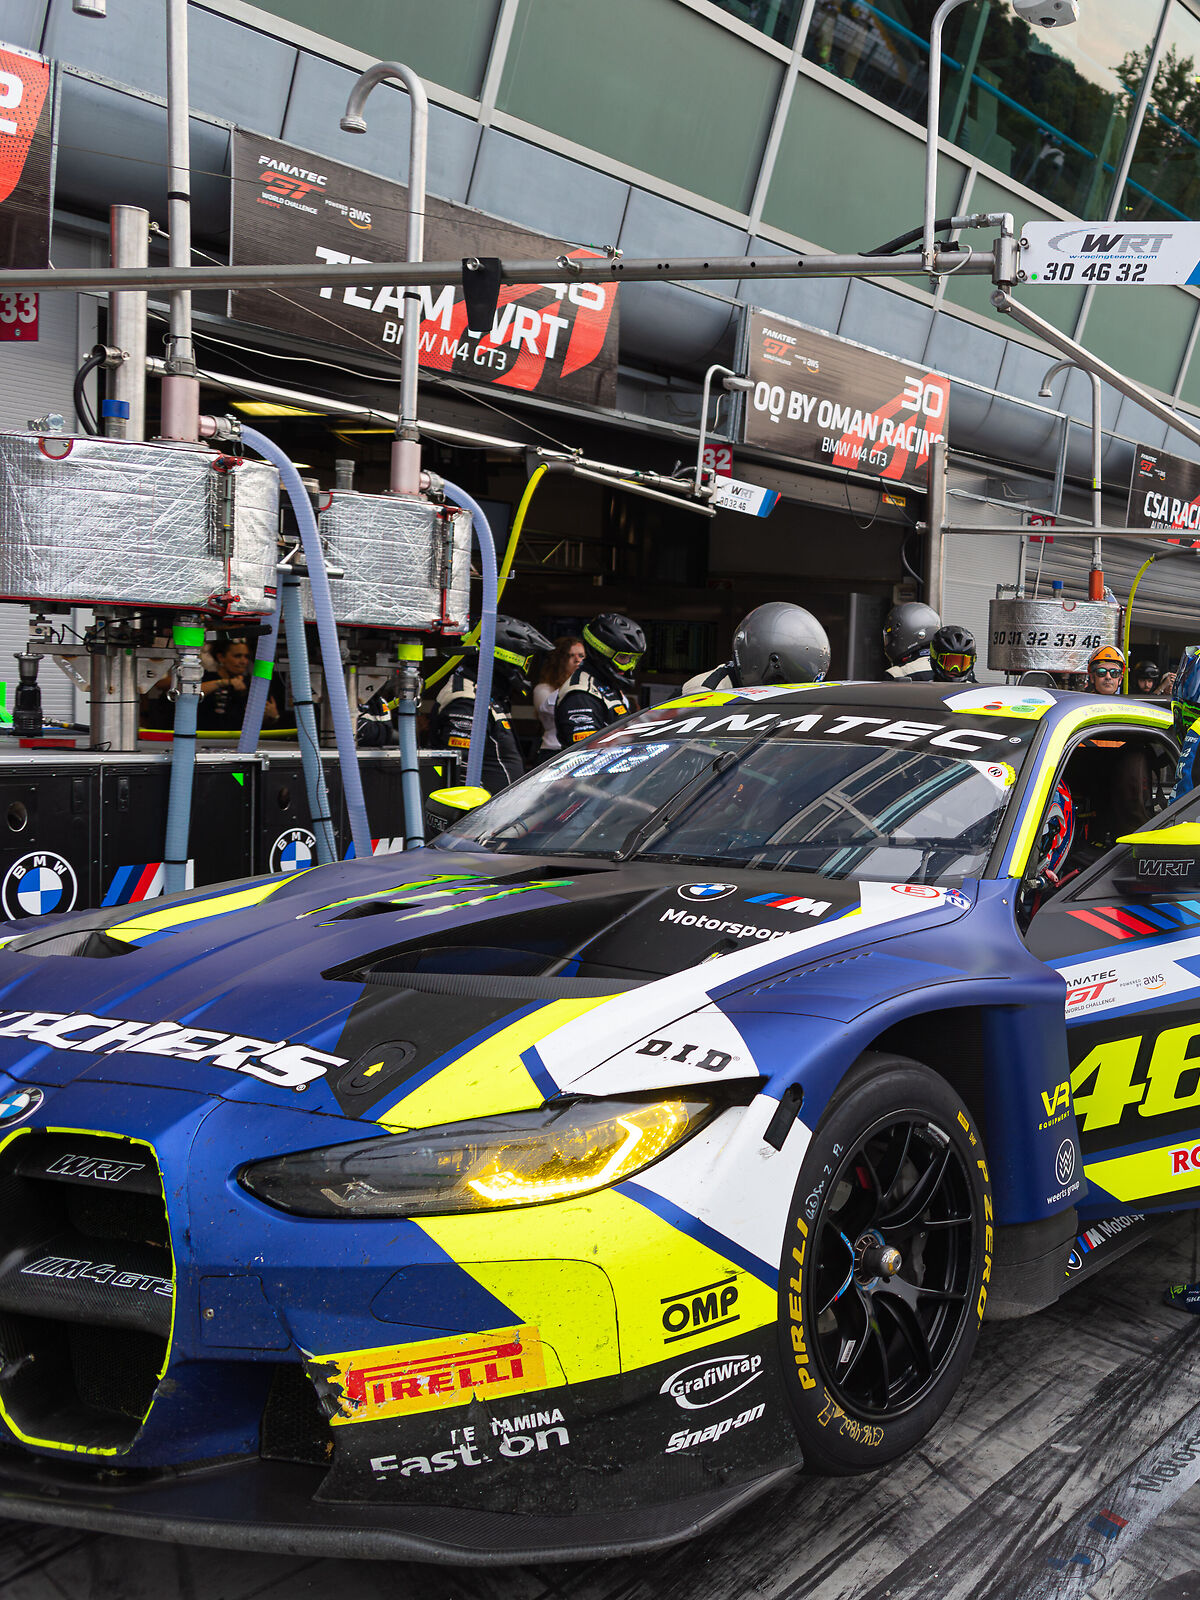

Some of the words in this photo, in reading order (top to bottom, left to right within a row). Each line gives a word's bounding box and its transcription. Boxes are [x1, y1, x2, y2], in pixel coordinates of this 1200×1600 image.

[258, 155, 328, 186] FANATEC
[259, 170, 328, 200] GT
[261, 191, 284, 205] WORLD
[284, 199, 319, 215] CHALLENGE
[348, 207, 372, 223] aws
[1080, 233, 1173, 253] WRT
[1043, 262, 1075, 282] 30
[1081, 263, 1115, 282] 46
[1115, 263, 1149, 282] 32
[382, 321, 438, 353] BW
[440, 339, 469, 362] M4
[473, 346, 507, 371] GT3
[762, 327, 797, 345] FANATEC
[901, 375, 944, 419] 30
[787, 390, 818, 423] BY
[817, 400, 879, 441] OMAN
[703, 449, 731, 470] 32
[822, 437, 851, 459] BMW
[851, 445, 867, 461] M4
[868, 447, 888, 467] GT3
[731, 485, 755, 499] WRT
[1143, 491, 1169, 521] CSA
[993, 631, 1006, 645] 30
[1007, 631, 1022, 645] 31
[1026, 632, 1049, 646] 32
[1053, 633, 1077, 648] 33
[1081, 635, 1101, 649] 46
[597, 712, 1009, 753] FANATEC
[13, 856, 69, 881] BMW
[1138, 859, 1196, 876] WRT
[1066, 968, 1117, 988] ANATEC
[1120, 978, 1142, 988] POWERED
[1143, 973, 1165, 986] aws
[1065, 1002, 1085, 1014] WORLD
[1085, 997, 1116, 1010] CHALLENGE
[1039, 1110, 1071, 1131] EQUIPMENT
[46, 1154, 145, 1183] WRT
[1046, 1187, 1067, 1205] weerts
[1067, 1181, 1080, 1197] group
[662, 1285, 739, 1333] OMP
[788, 1217, 817, 1390] PIRELLI
[341, 1342, 525, 1406] PIRELLI
[670, 1353, 763, 1398] GrafiWrap
[450, 1408, 565, 1444] ETAMINA
[664, 1402, 767, 1454] Snap-on
[370, 1426, 571, 1481] Faston
